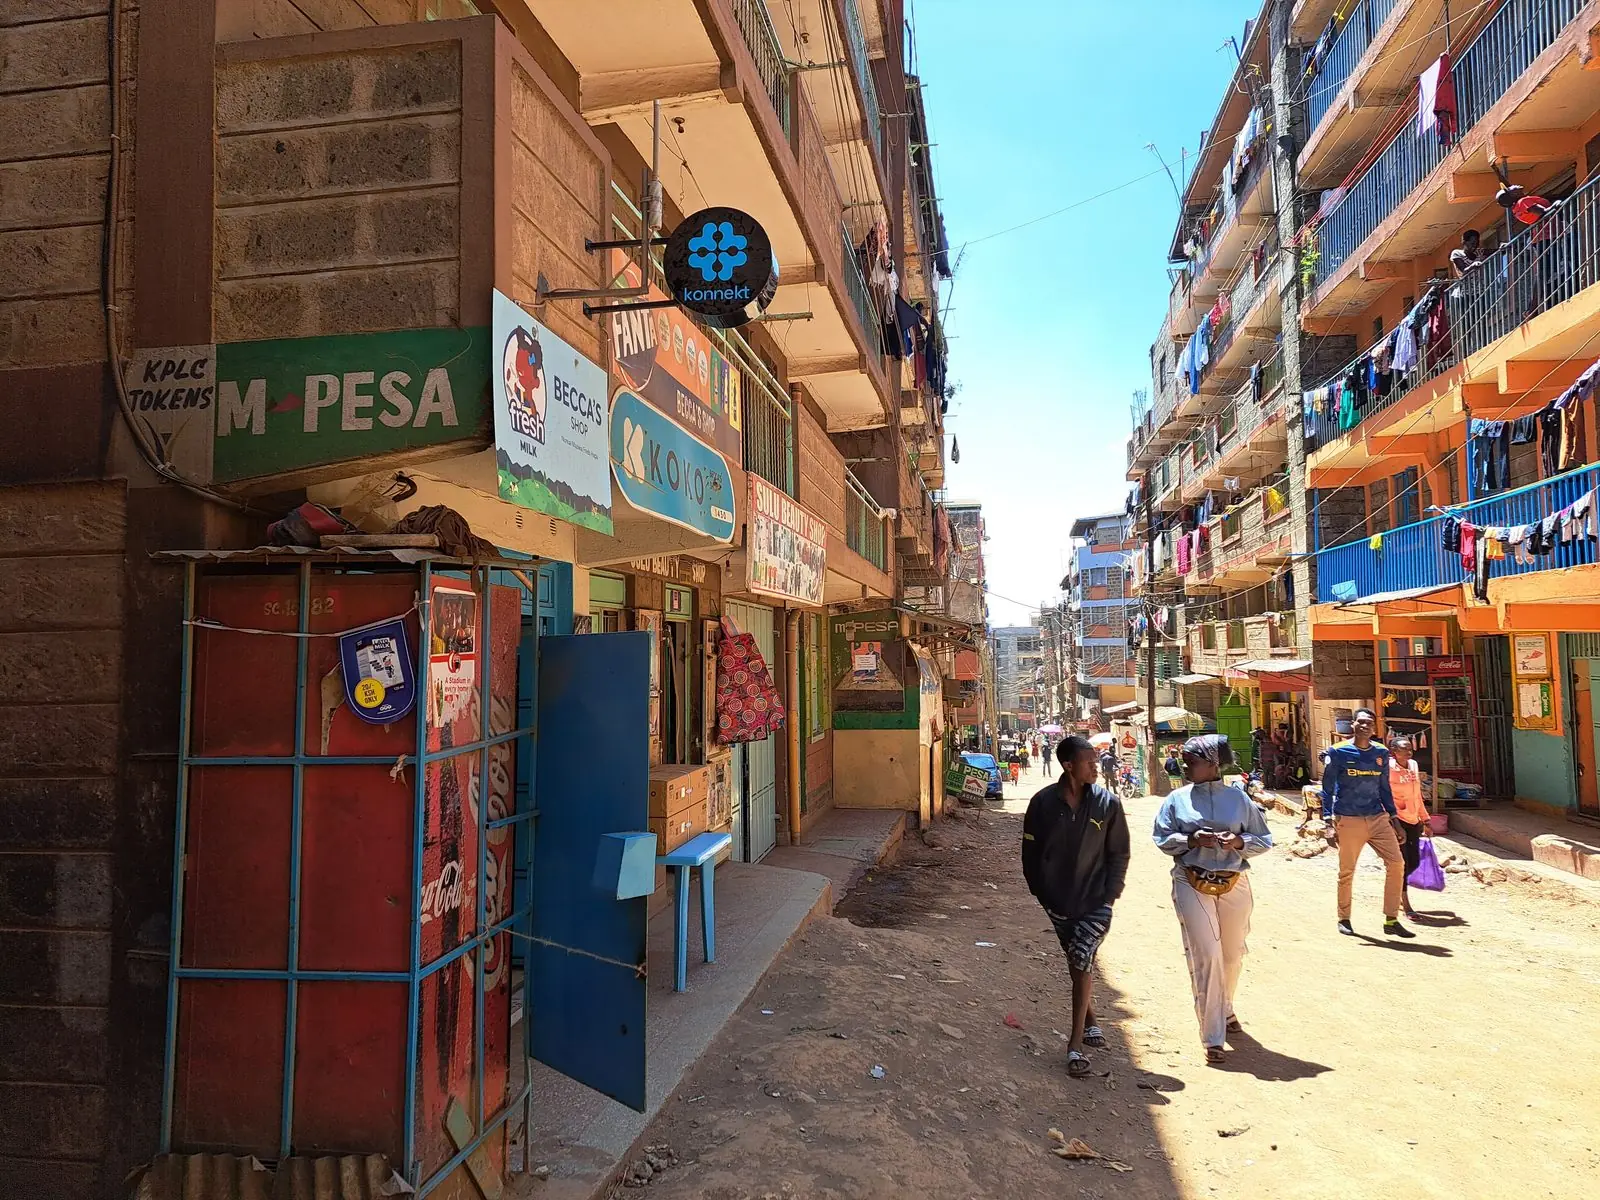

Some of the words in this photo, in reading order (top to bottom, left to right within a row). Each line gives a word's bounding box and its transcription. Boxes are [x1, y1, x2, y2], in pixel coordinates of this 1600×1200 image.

[684, 285, 750, 301] konnekt
[612, 300, 658, 359] FANTA
[143, 358, 209, 383] KPLC
[129, 386, 214, 413] TOKENS
[303, 367, 458, 432] PESA
[554, 374, 602, 426] BECCA'S
[508, 401, 545, 444] fresh
[570, 416, 588, 436] SHOP
[520, 439, 537, 458] MILK
[650, 440, 704, 505] KOKO
[756, 481, 780, 521] SULU
[782, 498, 809, 538] BEAUTY
[810, 517, 826, 549] SHOP
[449, 676, 466, 684] Stadium
[963, 765, 989, 782] PESA
